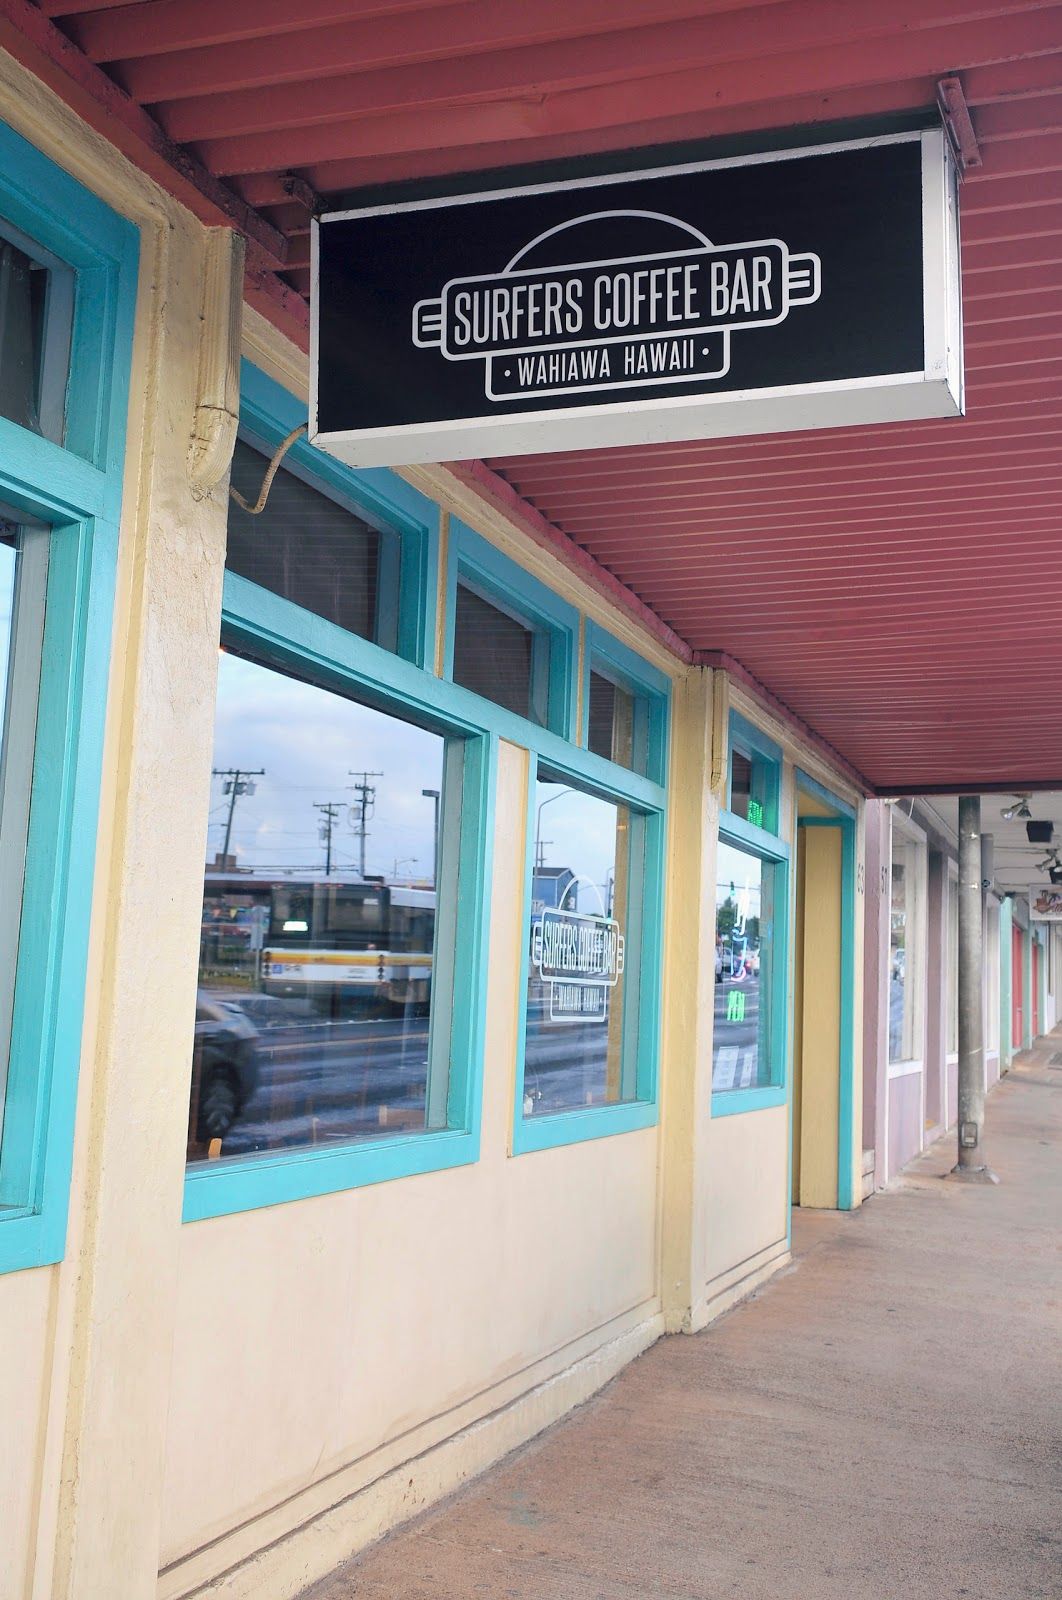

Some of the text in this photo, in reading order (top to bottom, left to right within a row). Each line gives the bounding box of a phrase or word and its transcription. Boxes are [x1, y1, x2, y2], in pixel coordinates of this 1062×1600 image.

[453, 255, 773, 346] SURFERS COFFEE BAR
[517, 339, 695, 387] WAHIAWA HAWAII
[543, 920, 617, 974] SURFERS COFFEE BAR
